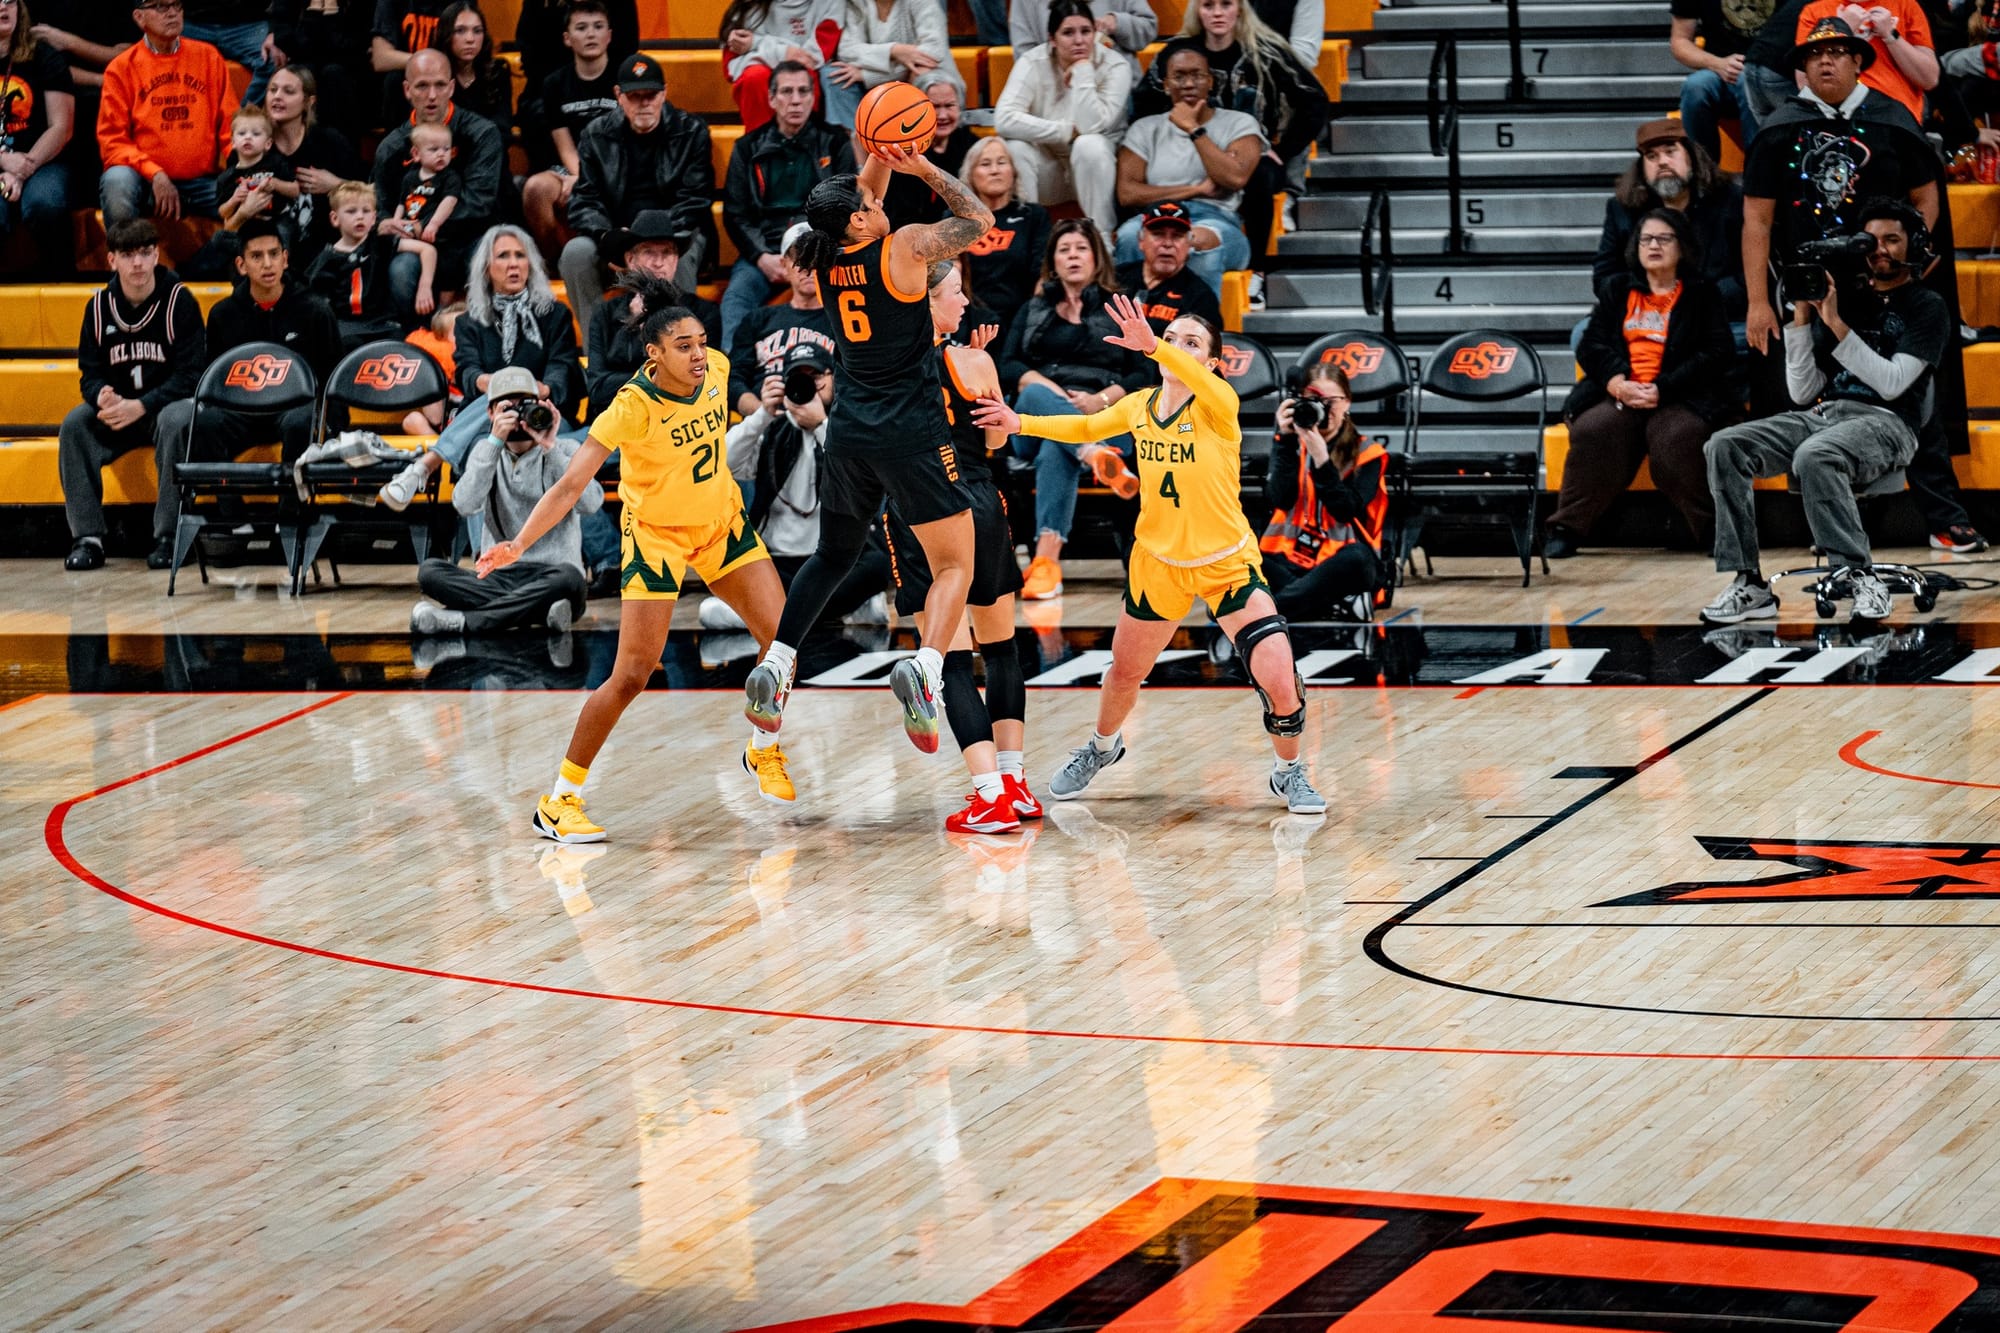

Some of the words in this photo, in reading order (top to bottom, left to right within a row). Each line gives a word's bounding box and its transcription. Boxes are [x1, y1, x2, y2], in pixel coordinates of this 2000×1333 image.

[1532, 48, 1549, 73] 7
[1496, 122, 1514, 148] 6
[1466, 199, 1484, 224] 5
[1435, 276, 1454, 302] 4
[838, 290, 872, 343] 6
[130, 364, 143, 390] 1
[225, 354, 292, 392] OSU
[353, 353, 422, 391] OSU
[1449, 342, 1518, 380] OSU
[691, 438, 719, 484] 21
[1159, 470, 1180, 508] 4
